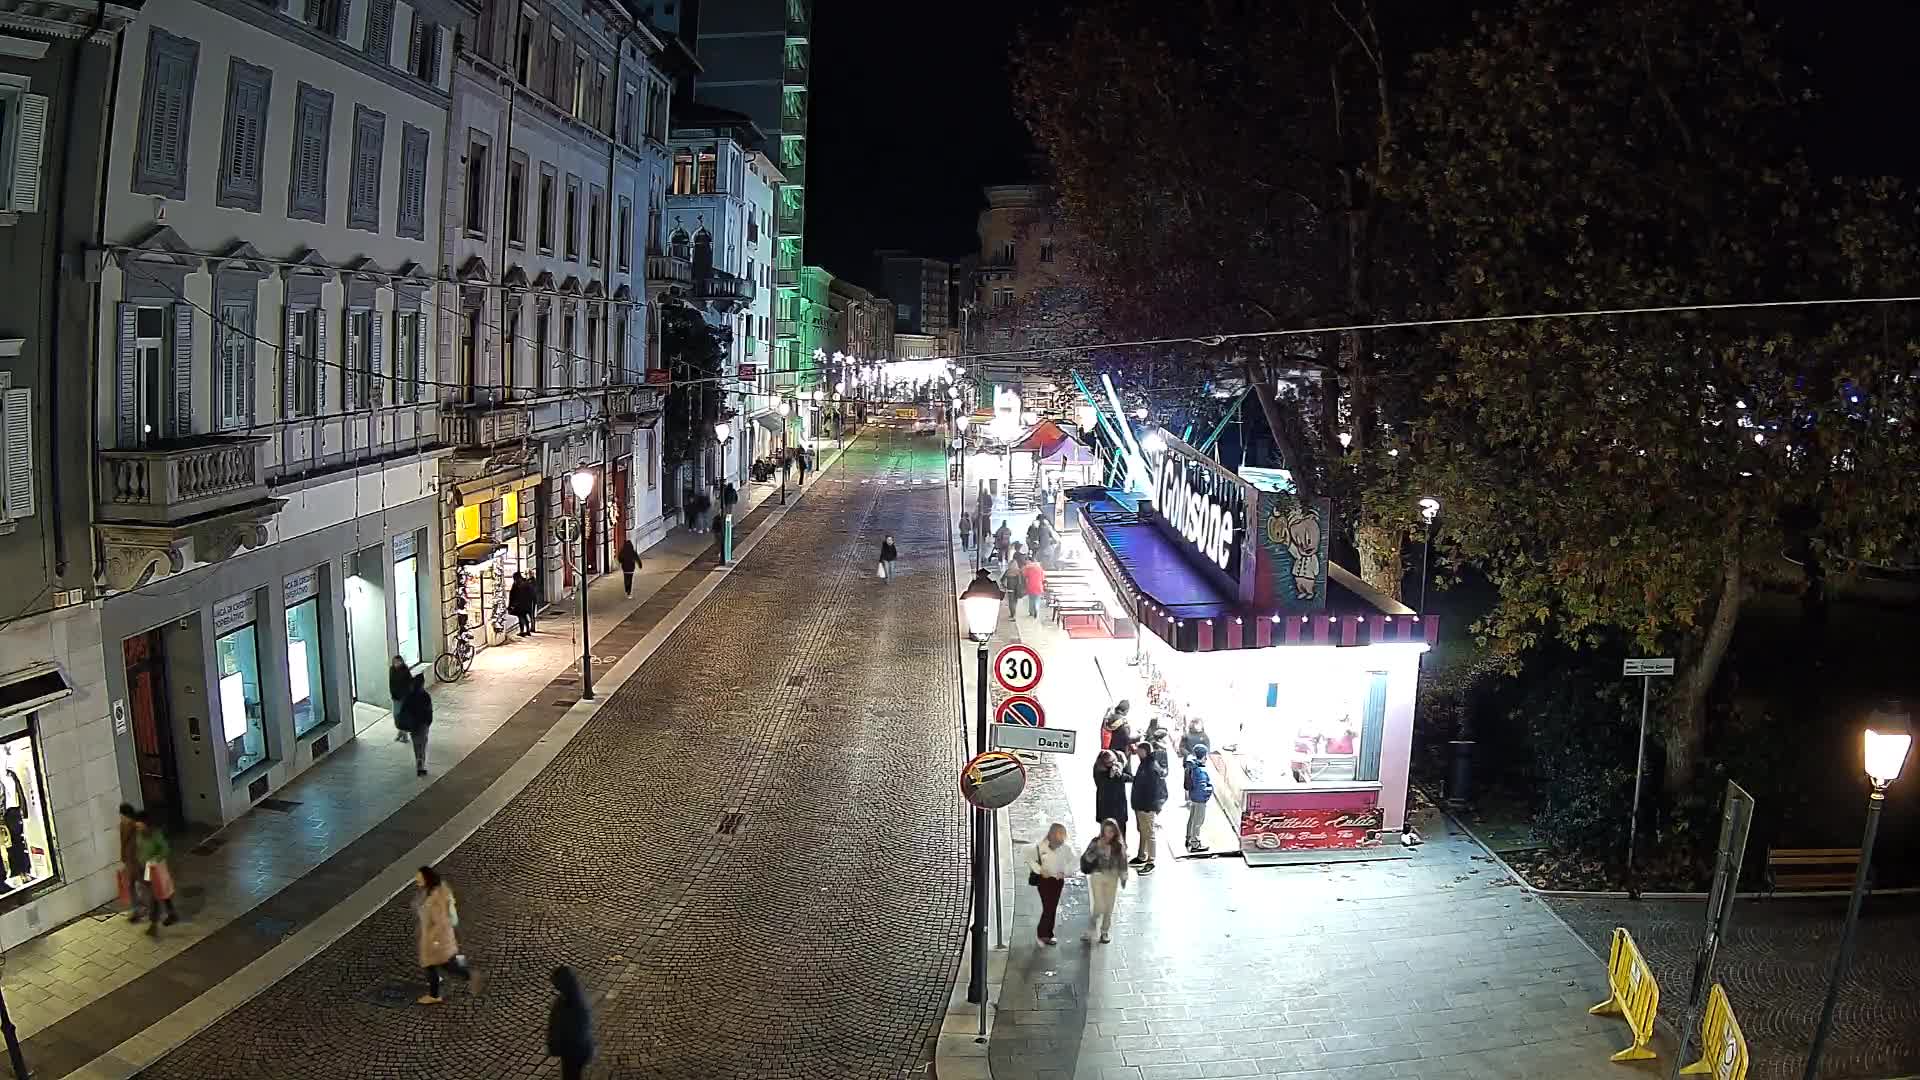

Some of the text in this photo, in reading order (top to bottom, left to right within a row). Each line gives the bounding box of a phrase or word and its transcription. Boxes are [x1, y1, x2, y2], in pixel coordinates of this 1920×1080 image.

[1162, 455, 1233, 570] Golosone
[1005, 657, 1032, 680] 30
[1038, 737, 1070, 749] Dante
